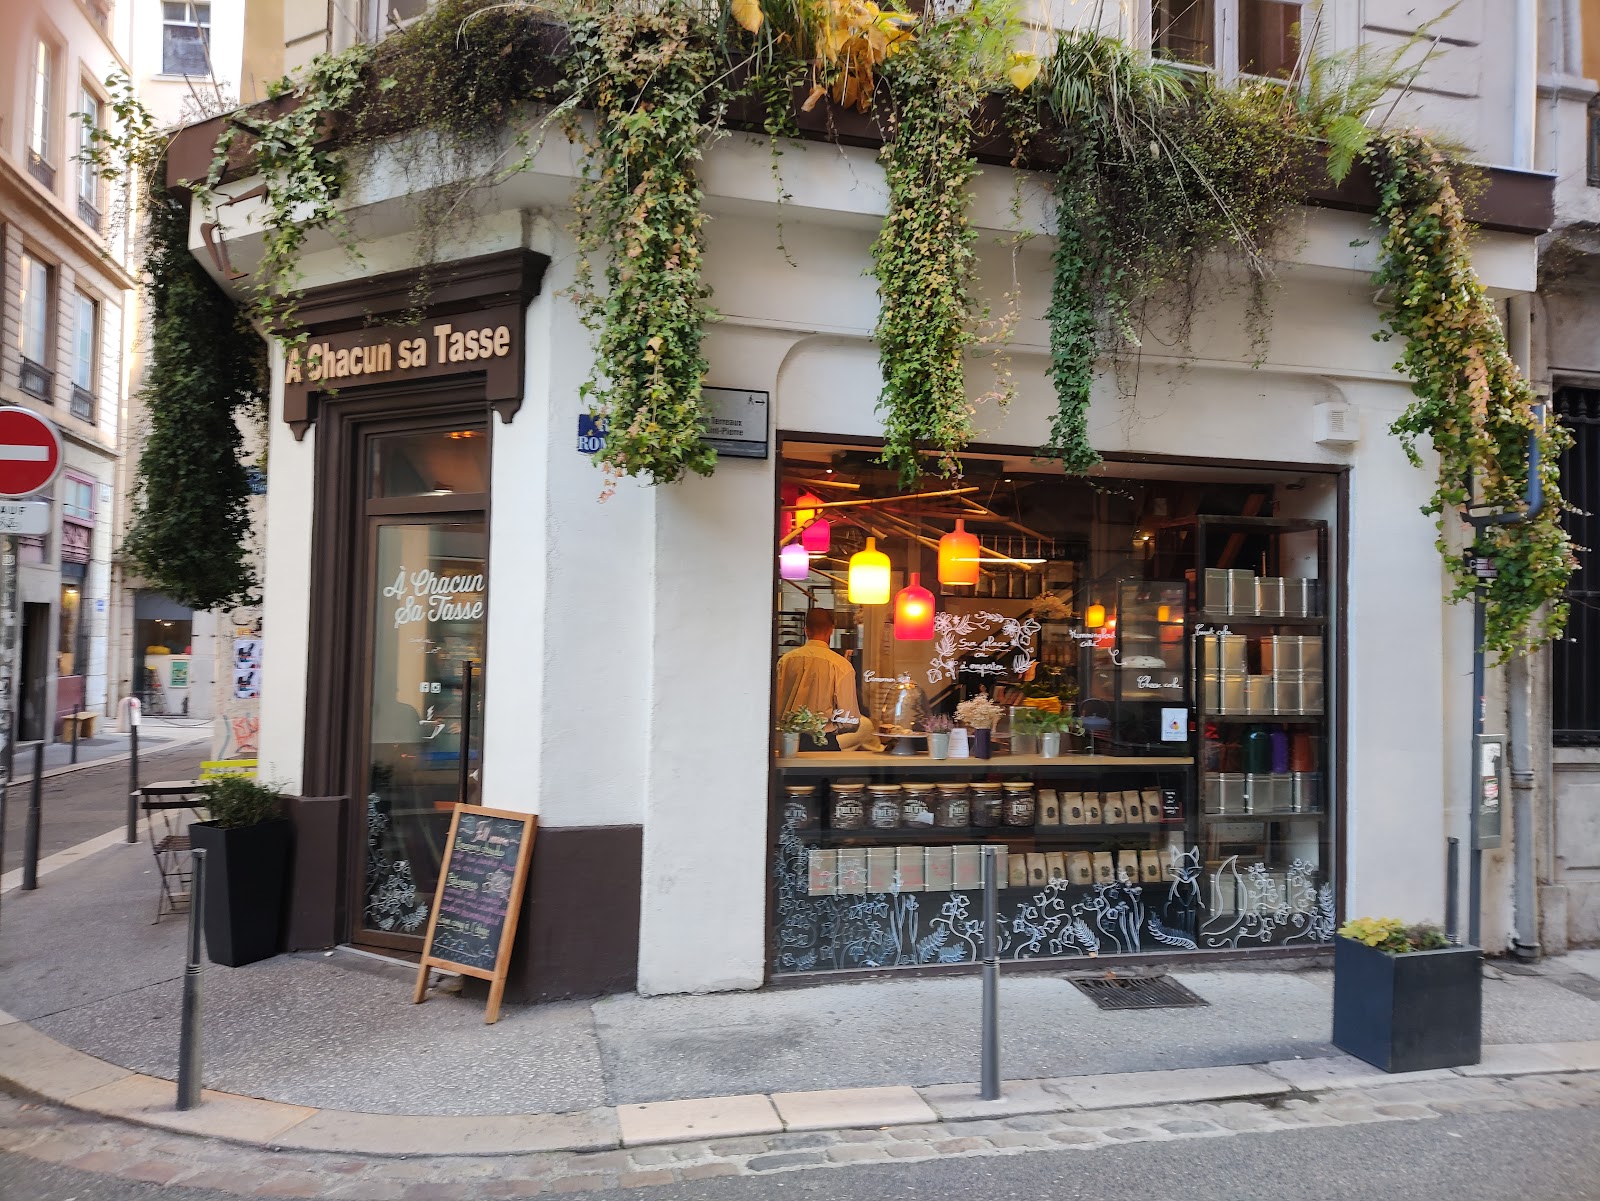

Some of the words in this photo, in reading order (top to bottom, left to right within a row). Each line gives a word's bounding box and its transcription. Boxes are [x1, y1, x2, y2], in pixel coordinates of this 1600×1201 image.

[307, 342, 392, 381] Chacun
[398, 337, 427, 369] sa
[434, 323, 510, 364] Tasse
[711, 416, 743, 426] Terreaux
[383, 566, 407, 600] À
[410, 569, 484, 597] Chacun
[394, 596, 426, 629] Sa
[428, 595, 484, 623] Tasse
[957, 638, 977, 648] Sur
[979, 636, 1009, 651] place
